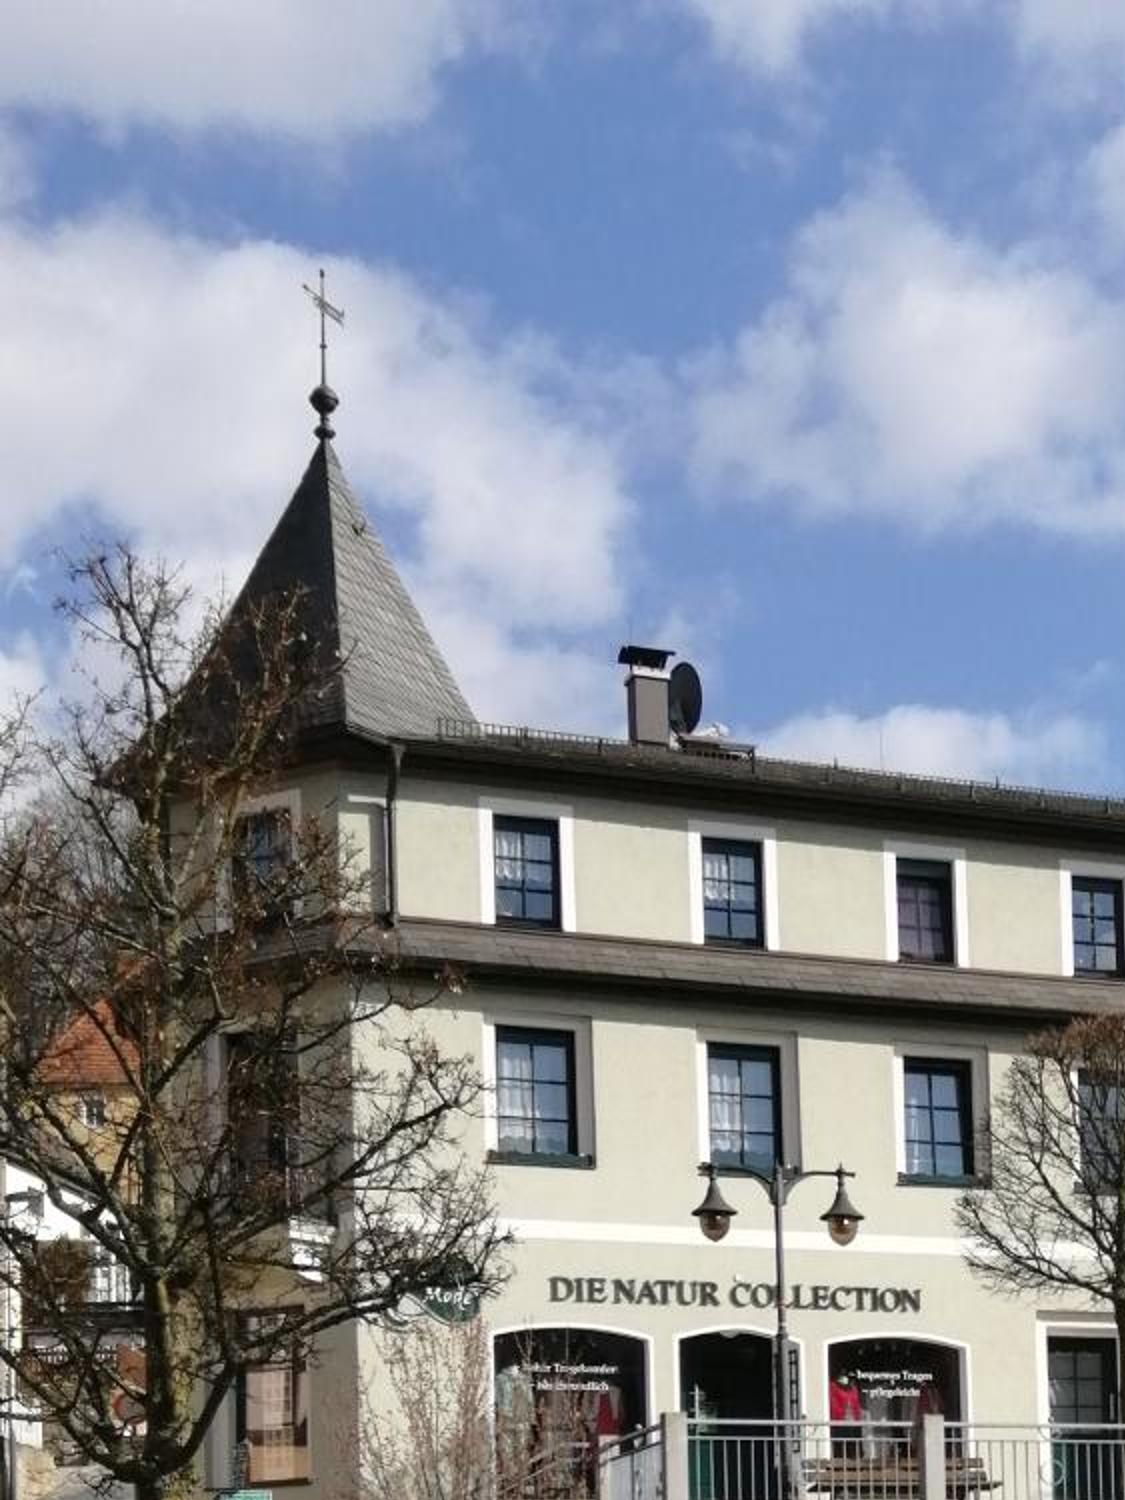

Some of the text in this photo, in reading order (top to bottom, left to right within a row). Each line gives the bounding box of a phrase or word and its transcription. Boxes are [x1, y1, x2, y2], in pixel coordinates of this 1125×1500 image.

[549, 1277, 921, 1312] DIE NATUR COLLECTION
